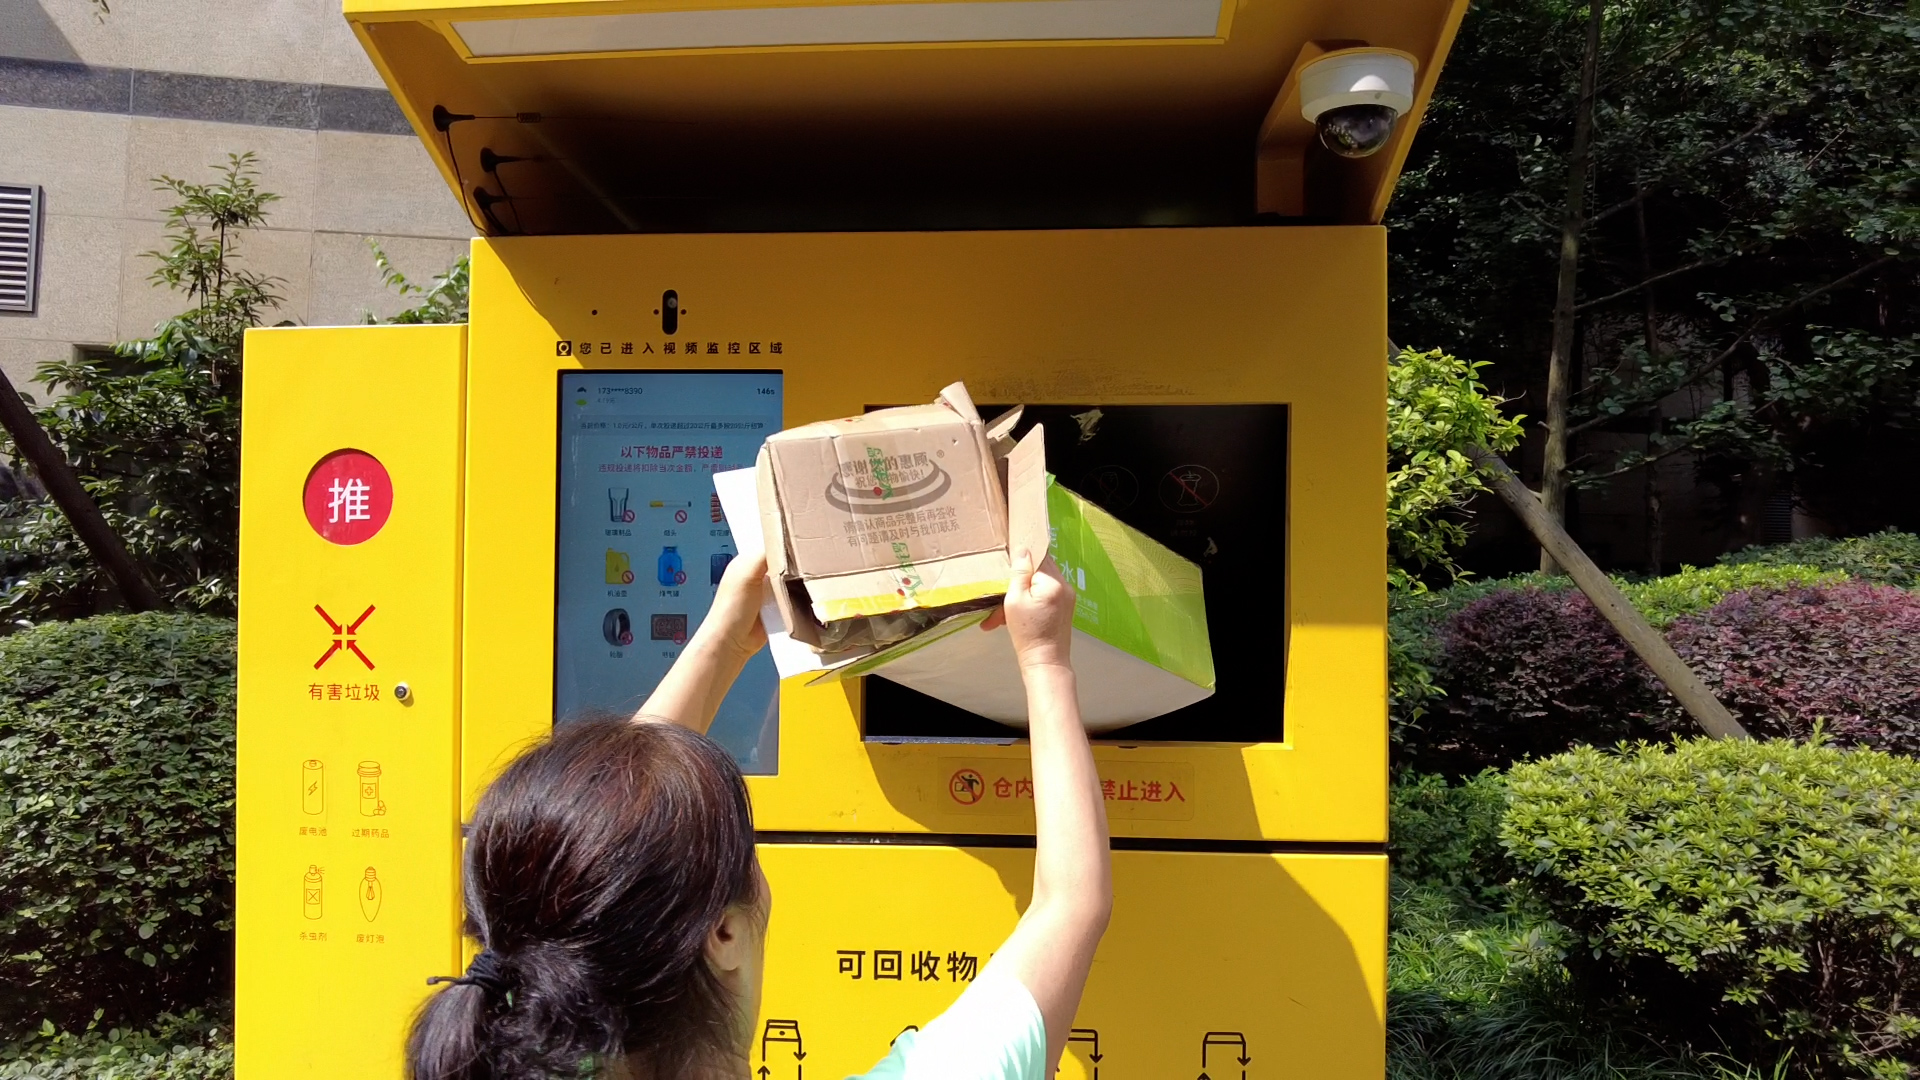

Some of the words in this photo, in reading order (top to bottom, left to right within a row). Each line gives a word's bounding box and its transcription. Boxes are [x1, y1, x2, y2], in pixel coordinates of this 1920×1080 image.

[579, 341, 783, 355] 您已进入视频监控区域
[756, 387, 776, 396] 146s
[620, 445, 724, 460] 以下物品严禁投递
[327, 477, 371, 524] 推
[604, 528, 632, 537] 玻璃制品
[663, 528, 677, 537] 烟头
[709, 529, 733, 538] 烟花爆
[847, 518, 961, 547] 有问题请及时与我们联系
[308, 682, 381, 702] 有害垃圾
[298, 825, 328, 837] 废电池
[351, 827, 390, 839] 过期药品
[298, 931, 328, 942] 杀虫剂
[355, 932, 385, 944] 废灯泡
[836, 949, 993, 983] 可回收物
